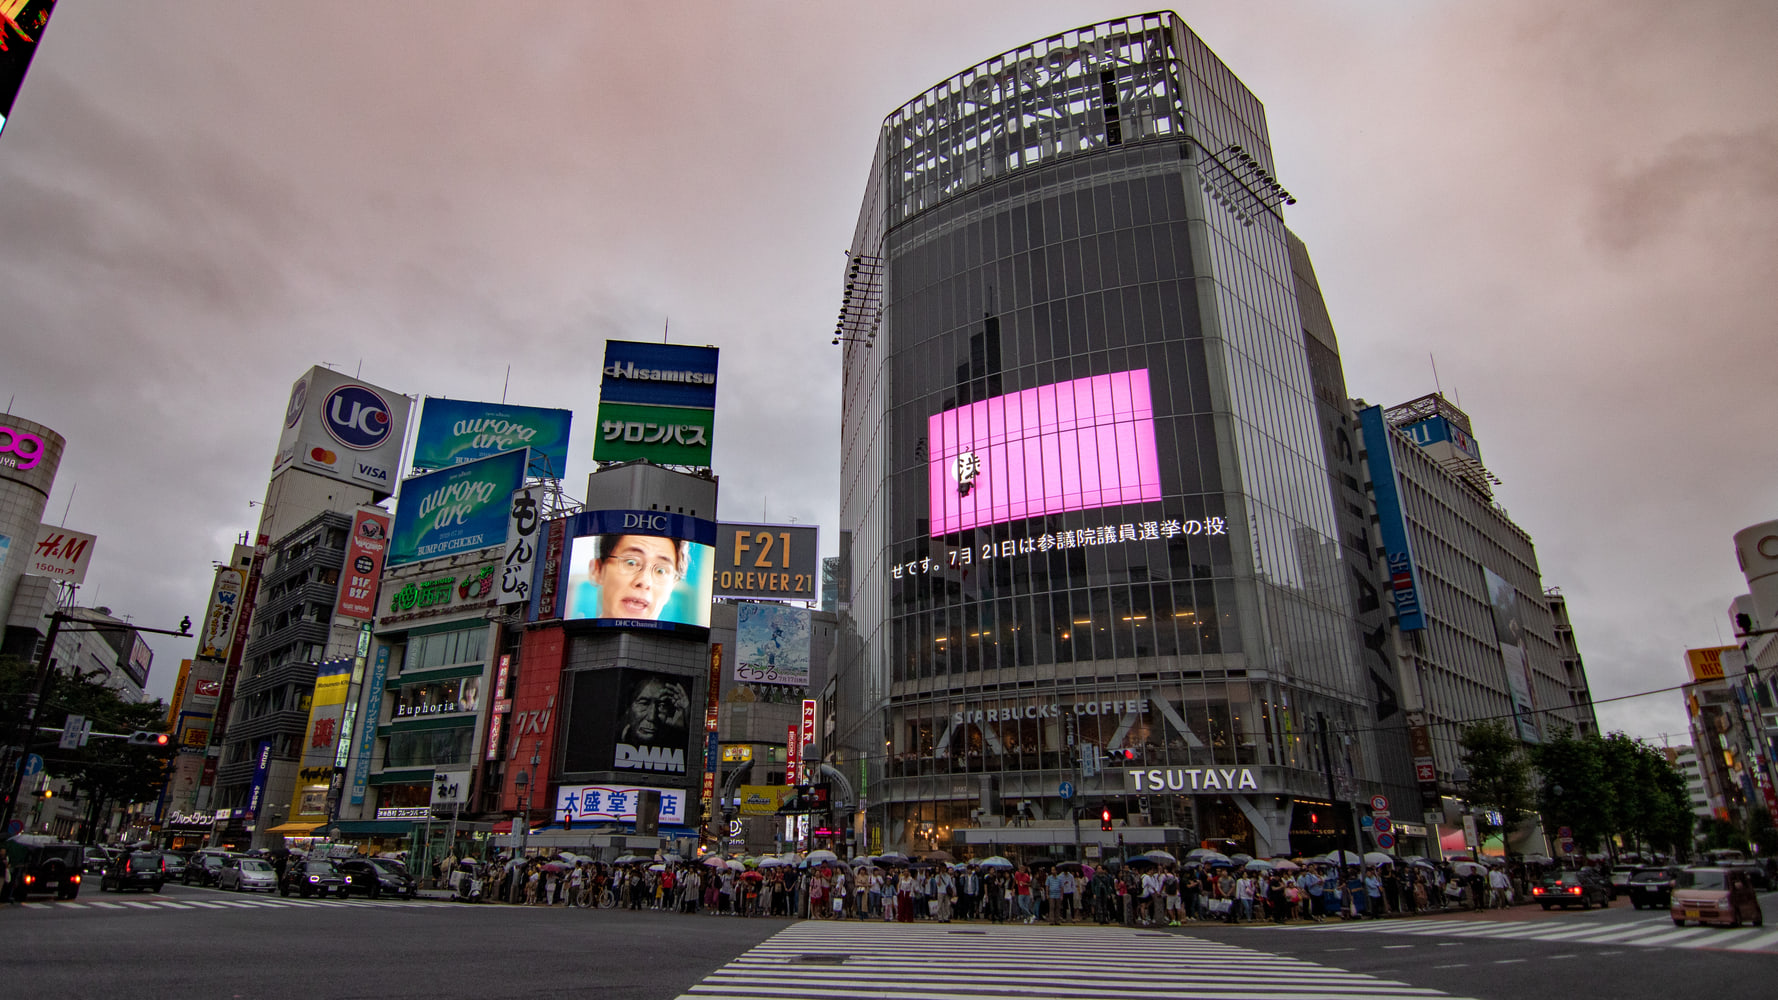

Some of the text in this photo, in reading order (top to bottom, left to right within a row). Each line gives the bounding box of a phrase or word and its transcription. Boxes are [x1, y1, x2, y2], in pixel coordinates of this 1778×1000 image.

[604, 361, 715, 384] Hisamitsu
[330, 395, 386, 436] UC
[453, 418, 537, 442] aurora
[472, 433, 512, 451] arc
[602, 419, 706, 446] サロンパス
[358, 463, 387, 480] VISA
[419, 480, 496, 519] aurora
[434, 503, 472, 530] arc
[623, 513, 667, 530] DHC
[34, 532, 88, 564] H&M
[417, 533, 484, 556] BUMP OF CHICKEN
[501, 490, 538, 598] もんじゃ
[734, 531, 791, 568] F21
[891, 556, 940, 579] せです。
[982, 516, 1228, 560] 21日は参議院議員選挙の投
[36, 562, 64, 575] 150m
[349, 587, 369, 599] B2F
[794, 574, 812, 592] 21
[1389, 551, 1418, 616] SEIBU
[737, 663, 778, 680] そらる
[398, 701, 455, 717] Euphoria
[954, 699, 1150, 726] STARBUCKS COFFEE
[804, 706, 813, 741] カラオ
[614, 743, 686, 773] DMM
[787, 761, 795, 786] カラ
[1129, 768, 1258, 792] TSUTAYA
[564, 791, 677, 815] 大盛堂店
